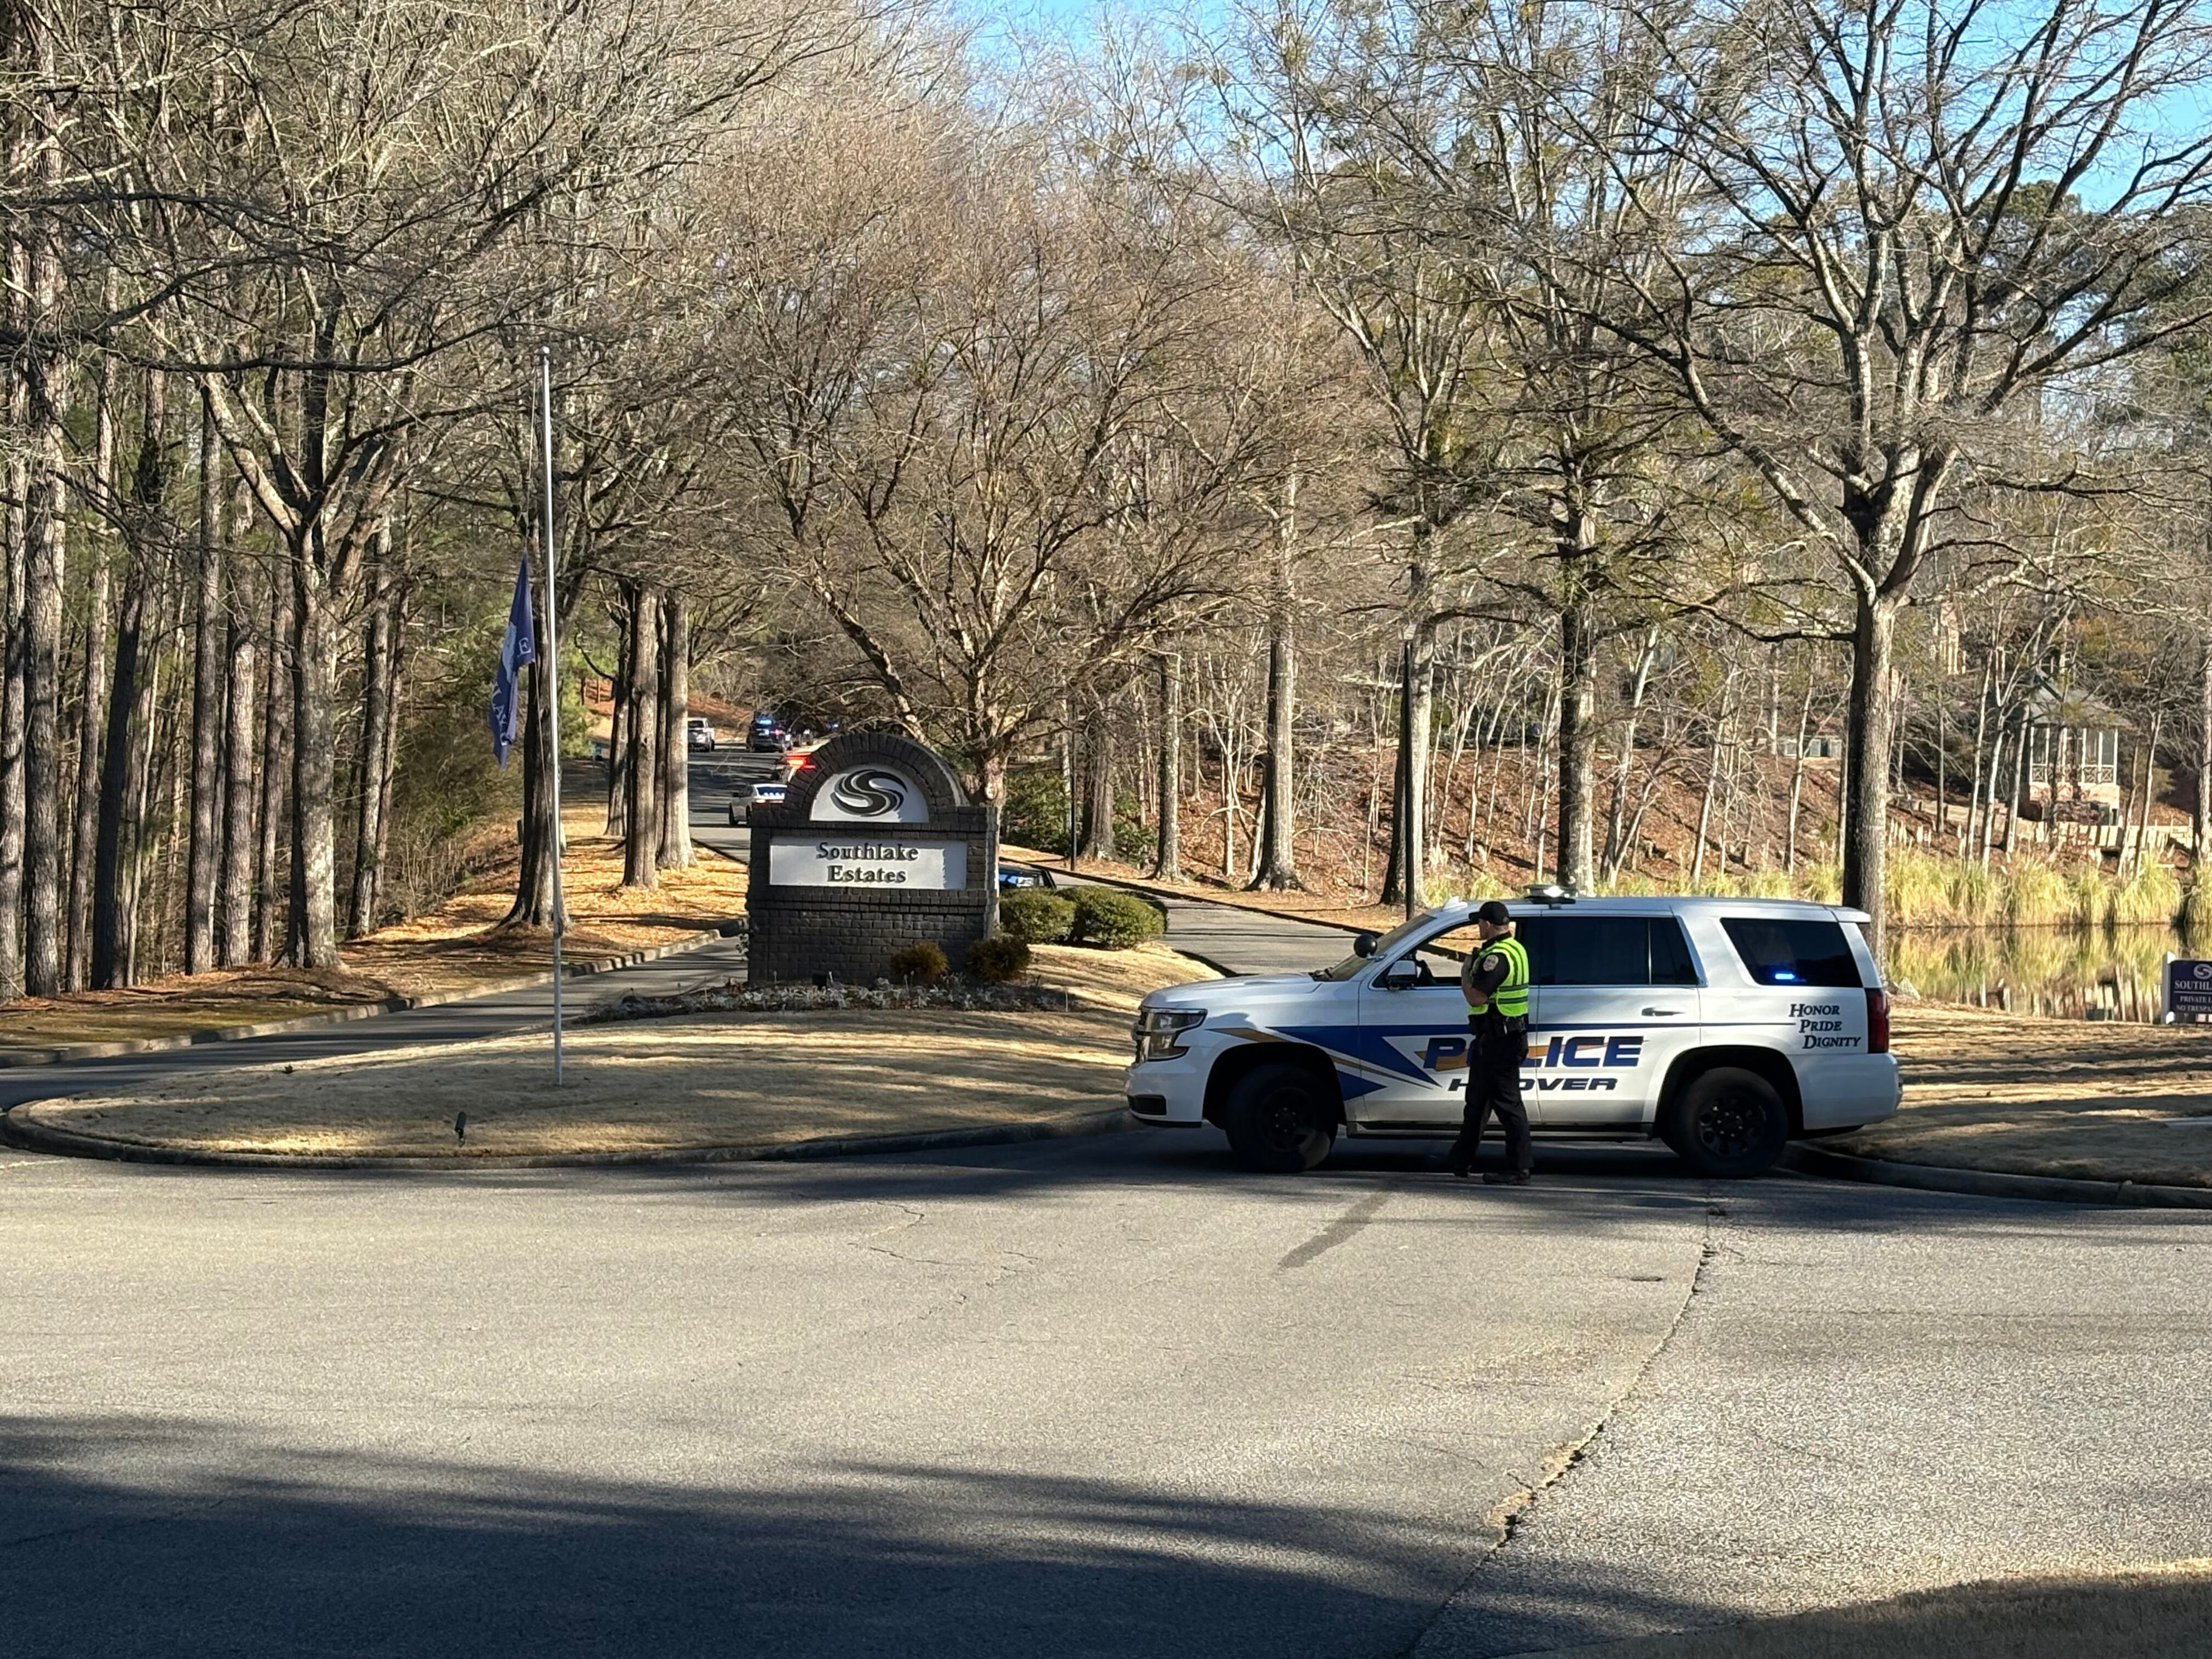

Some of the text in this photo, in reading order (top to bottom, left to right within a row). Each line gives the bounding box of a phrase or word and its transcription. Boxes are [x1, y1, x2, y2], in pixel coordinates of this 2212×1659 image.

[816, 842, 919, 861] Southlake
[827, 865, 907, 883] Estates
[1423, 1036, 1645, 1069] PICE
[1447, 1078, 1618, 1091] HOVER
